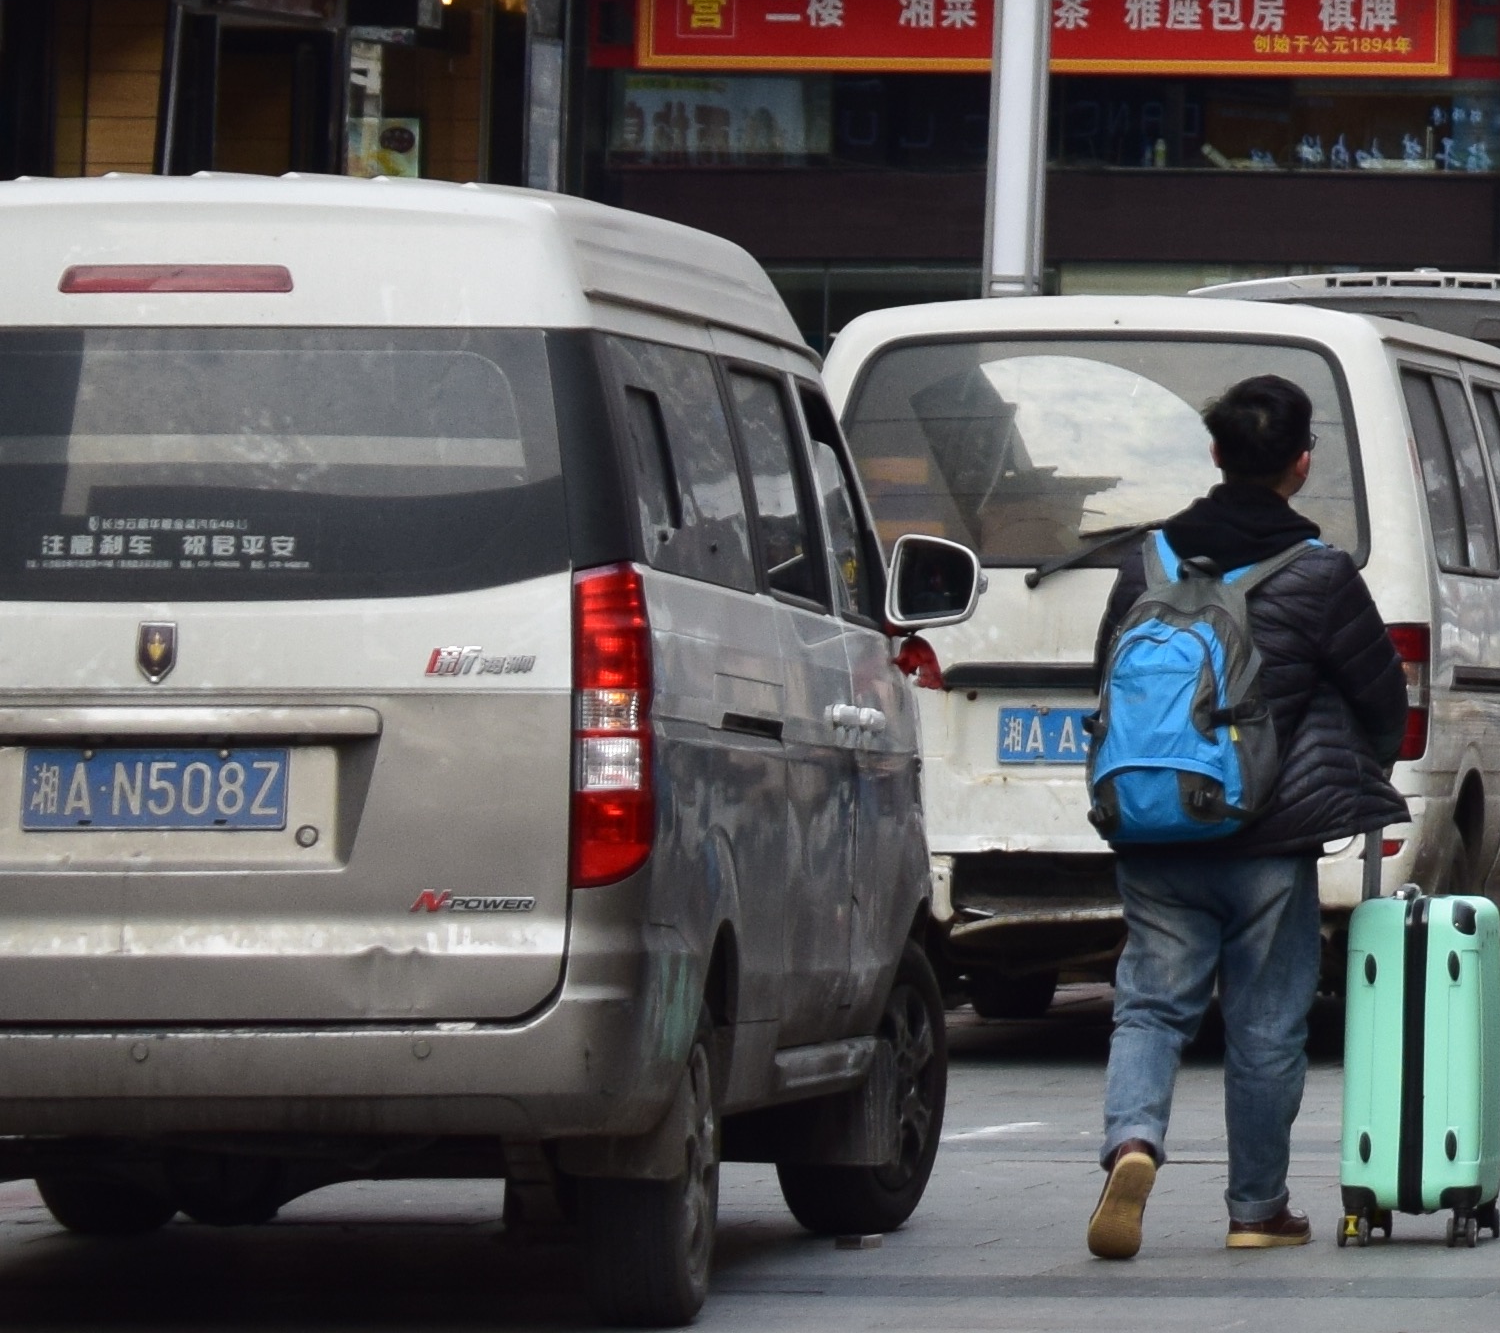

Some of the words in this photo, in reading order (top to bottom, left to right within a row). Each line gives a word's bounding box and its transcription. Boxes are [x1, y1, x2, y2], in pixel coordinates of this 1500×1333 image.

[41, 535, 153, 556] 注意刹车
[182, 535, 296, 557] 祝君平安
[425, 645, 537, 677] 新海狮
